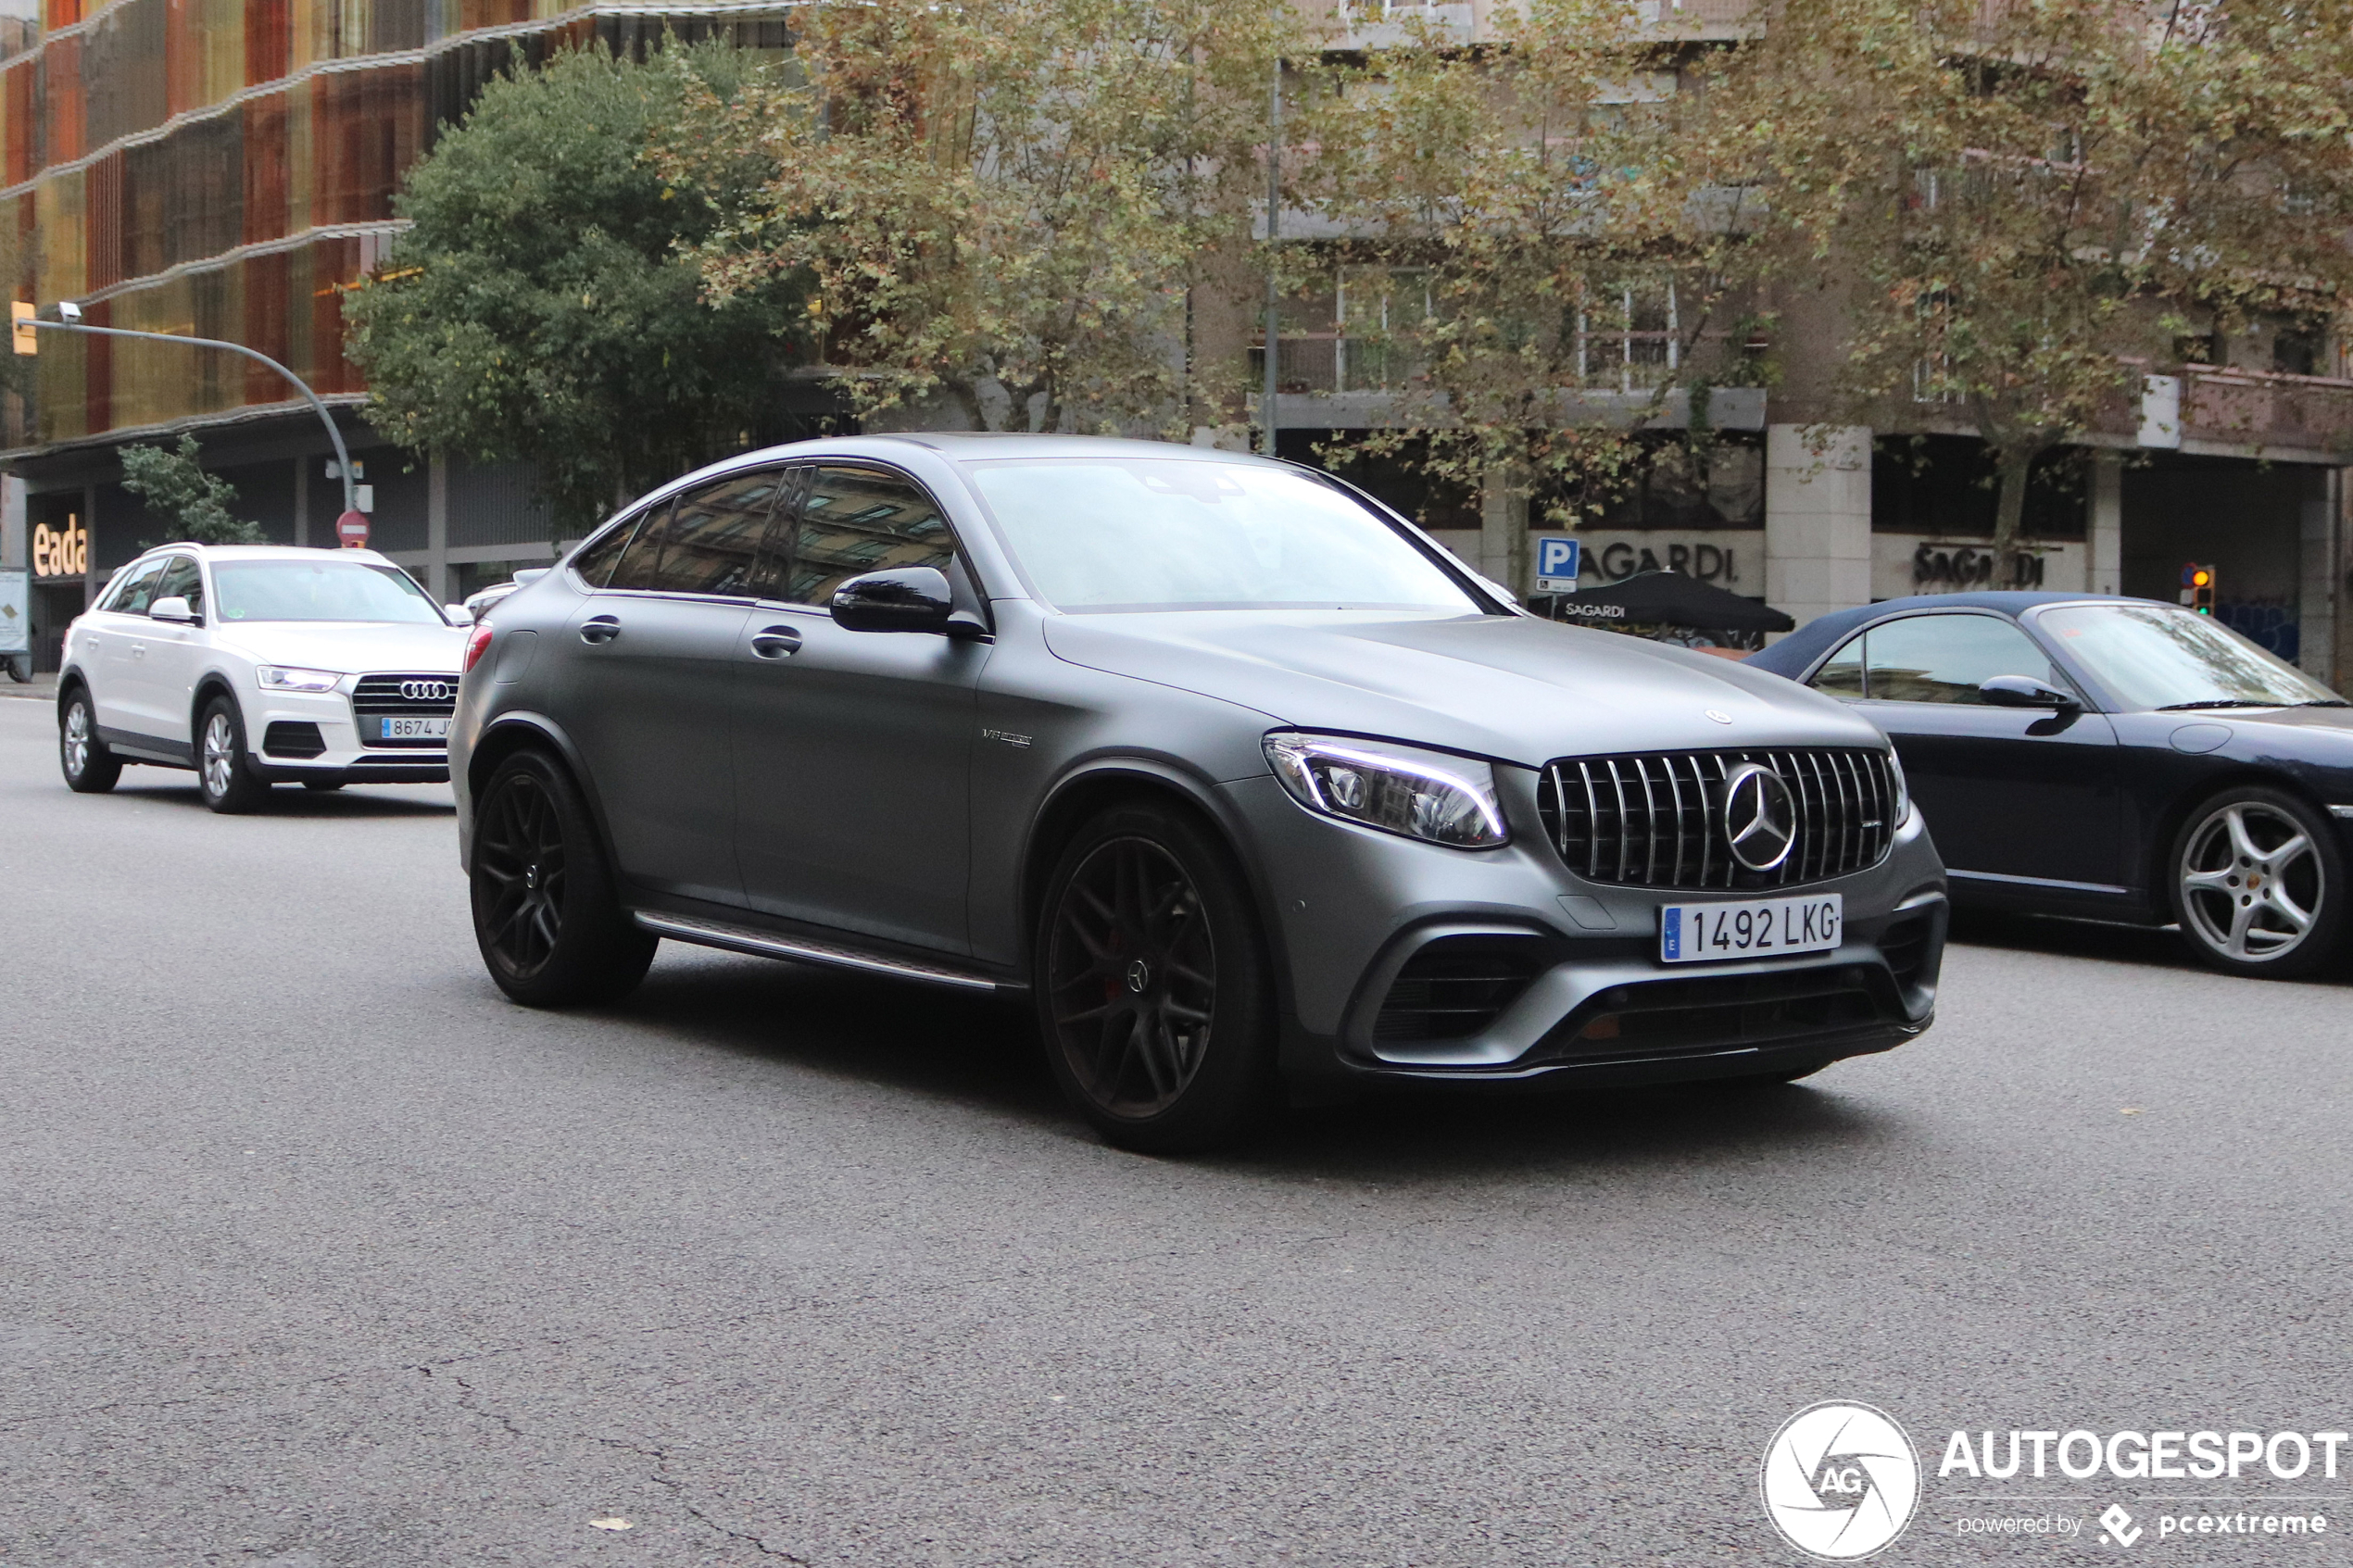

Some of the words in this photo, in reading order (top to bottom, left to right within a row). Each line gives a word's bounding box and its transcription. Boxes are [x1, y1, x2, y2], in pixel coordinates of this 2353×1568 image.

[33, 513, 88, 577] eada
[1544, 542, 1572, 574] P
[1565, 603, 1625, 618] SAGARDI
[394, 720, 433, 735] 8674
[438, 720, 451, 735] J
[1694, 909, 1773, 952] 1492
[1785, 902, 1834, 946] LKG
